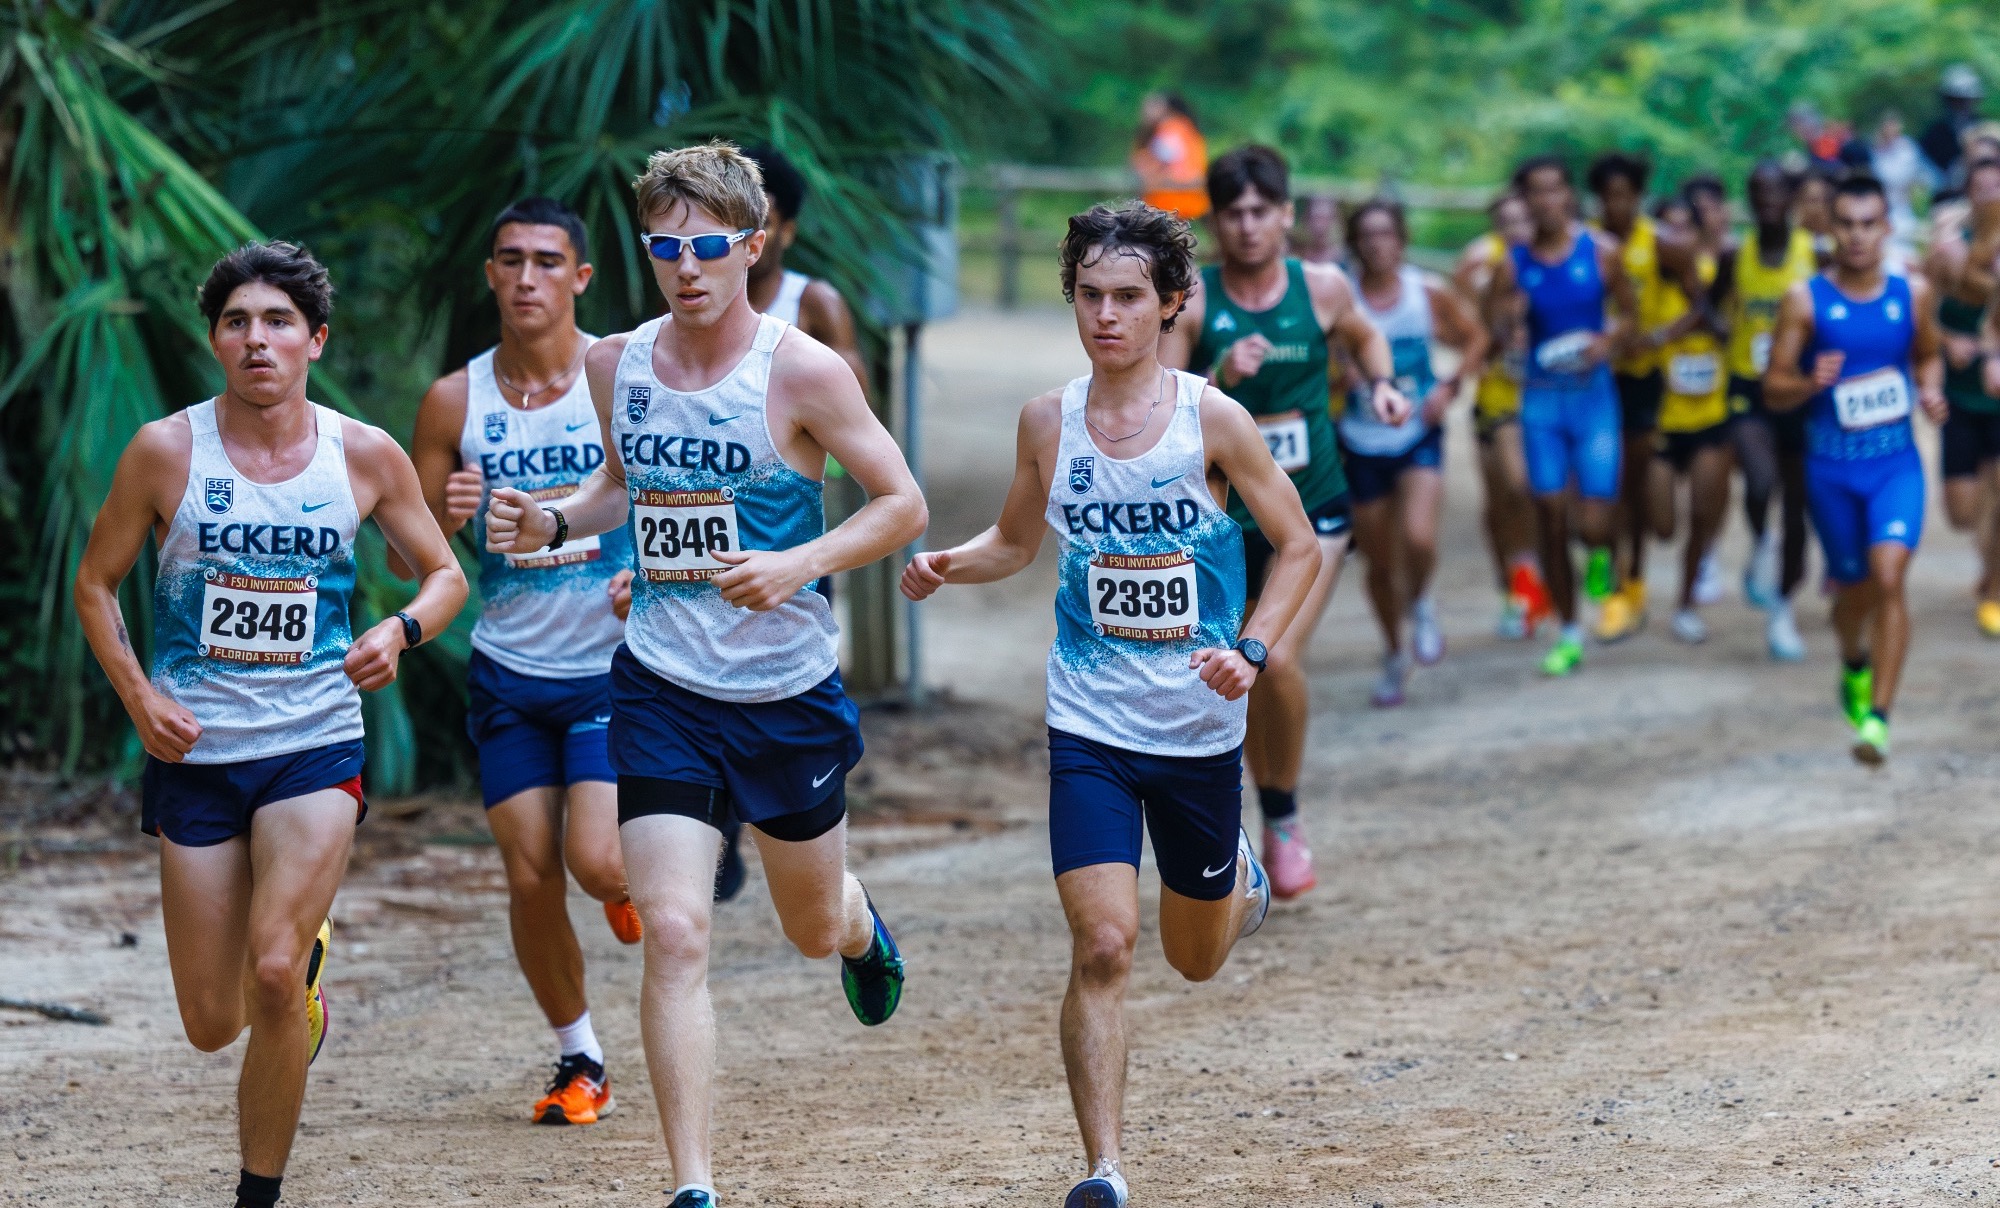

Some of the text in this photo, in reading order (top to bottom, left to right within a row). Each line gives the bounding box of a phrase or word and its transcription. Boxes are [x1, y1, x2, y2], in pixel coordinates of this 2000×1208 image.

[629, 388, 649, 399] SSC
[1266, 432, 1297, 460] 21
[620, 432, 751, 476] ECKERD
[480, 443, 605, 480] ECKERD
[1072, 459, 1093, 468] SSC
[208, 480, 231, 490] SSC
[649, 492, 725, 505] FSU INVITATIONAL
[1061, 498, 1200, 535] ECKERD
[198, 522, 341, 559] ECKERD
[641, 516, 730, 558] 2346
[557, 551, 588, 564] STATE
[1109, 556, 1125, 567] FSU
[650, 570, 690, 580] FLORIDA
[230, 576, 249, 589] FSU
[1096, 576, 1190, 619] 2339
[210, 597, 308, 642] 2348
[1107, 626, 1186, 639] FLORIDA STATE
[214, 647, 297, 662] FLORIDA STATE
